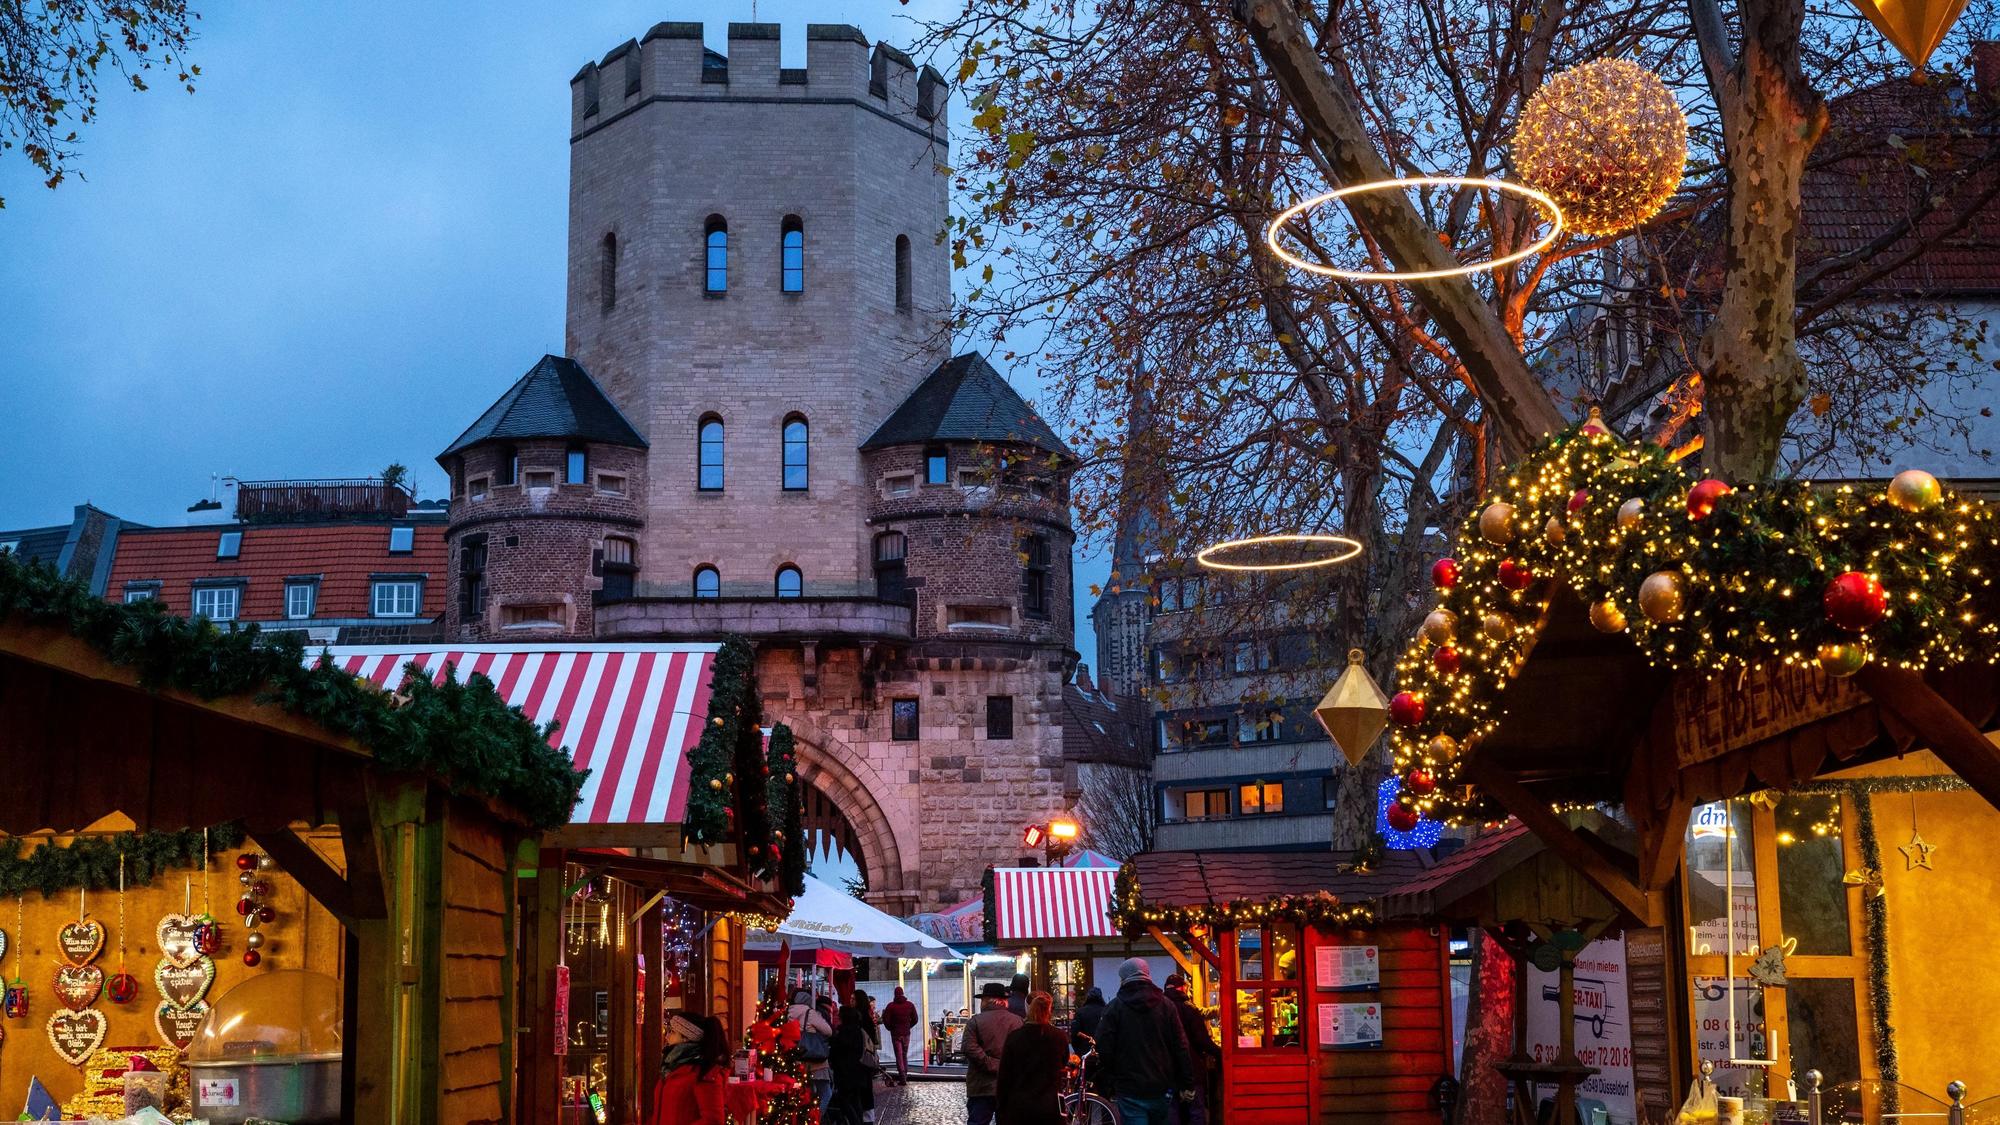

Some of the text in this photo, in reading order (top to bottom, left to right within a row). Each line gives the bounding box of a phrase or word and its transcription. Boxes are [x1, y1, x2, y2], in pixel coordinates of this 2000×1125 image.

[1596, 961, 1619, 973] mieten
[1573, 990, 1602, 1009] ER-TAXI
[1703, 1019, 1720, 1031] 08
[1598, 1047, 1608, 1066] 72
[1610, 1047, 1621, 1067] 20
[1599, 1078, 1629, 1097] Düsseldorf
